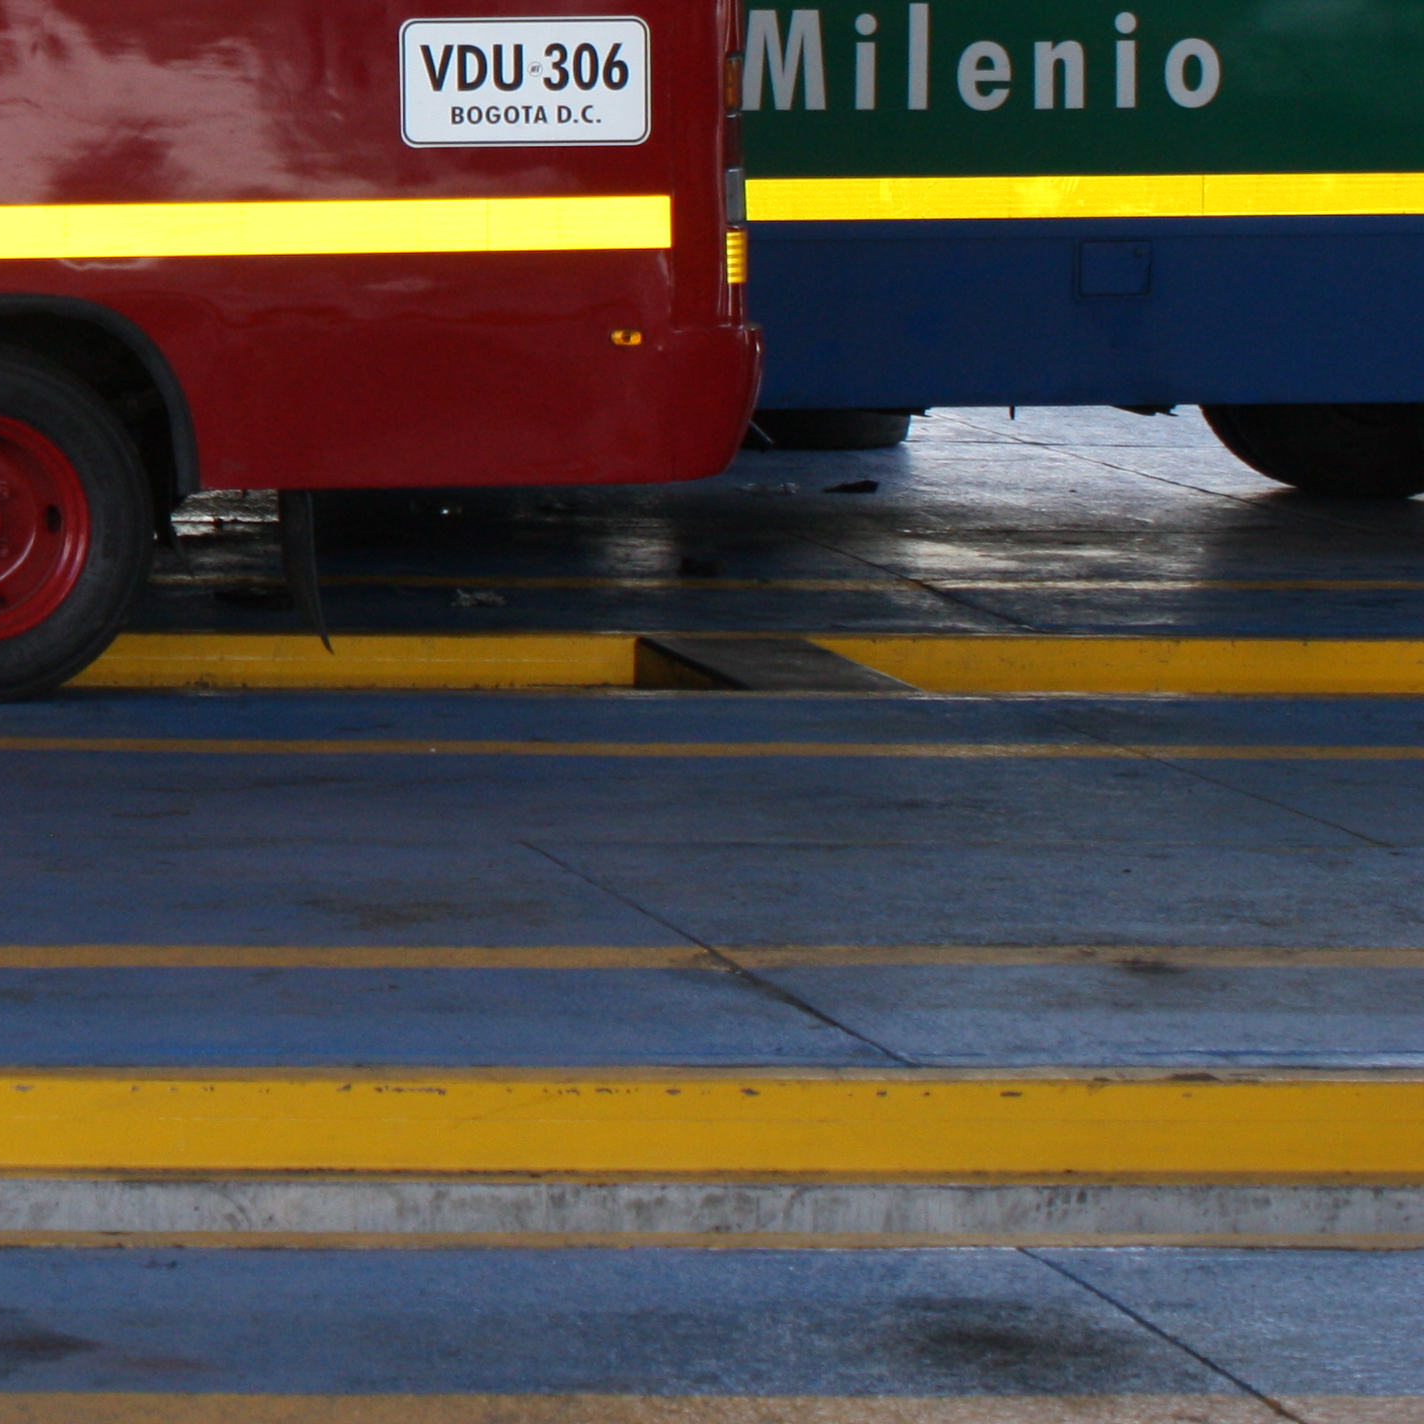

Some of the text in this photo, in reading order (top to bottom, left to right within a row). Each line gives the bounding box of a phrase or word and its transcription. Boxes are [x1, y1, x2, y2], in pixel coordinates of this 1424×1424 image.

[419, 42, 630, 93] VDU 306
[742, 1, 1222, 112] Milenio
[451, 104, 602, 126] BOGOTA D.C.
